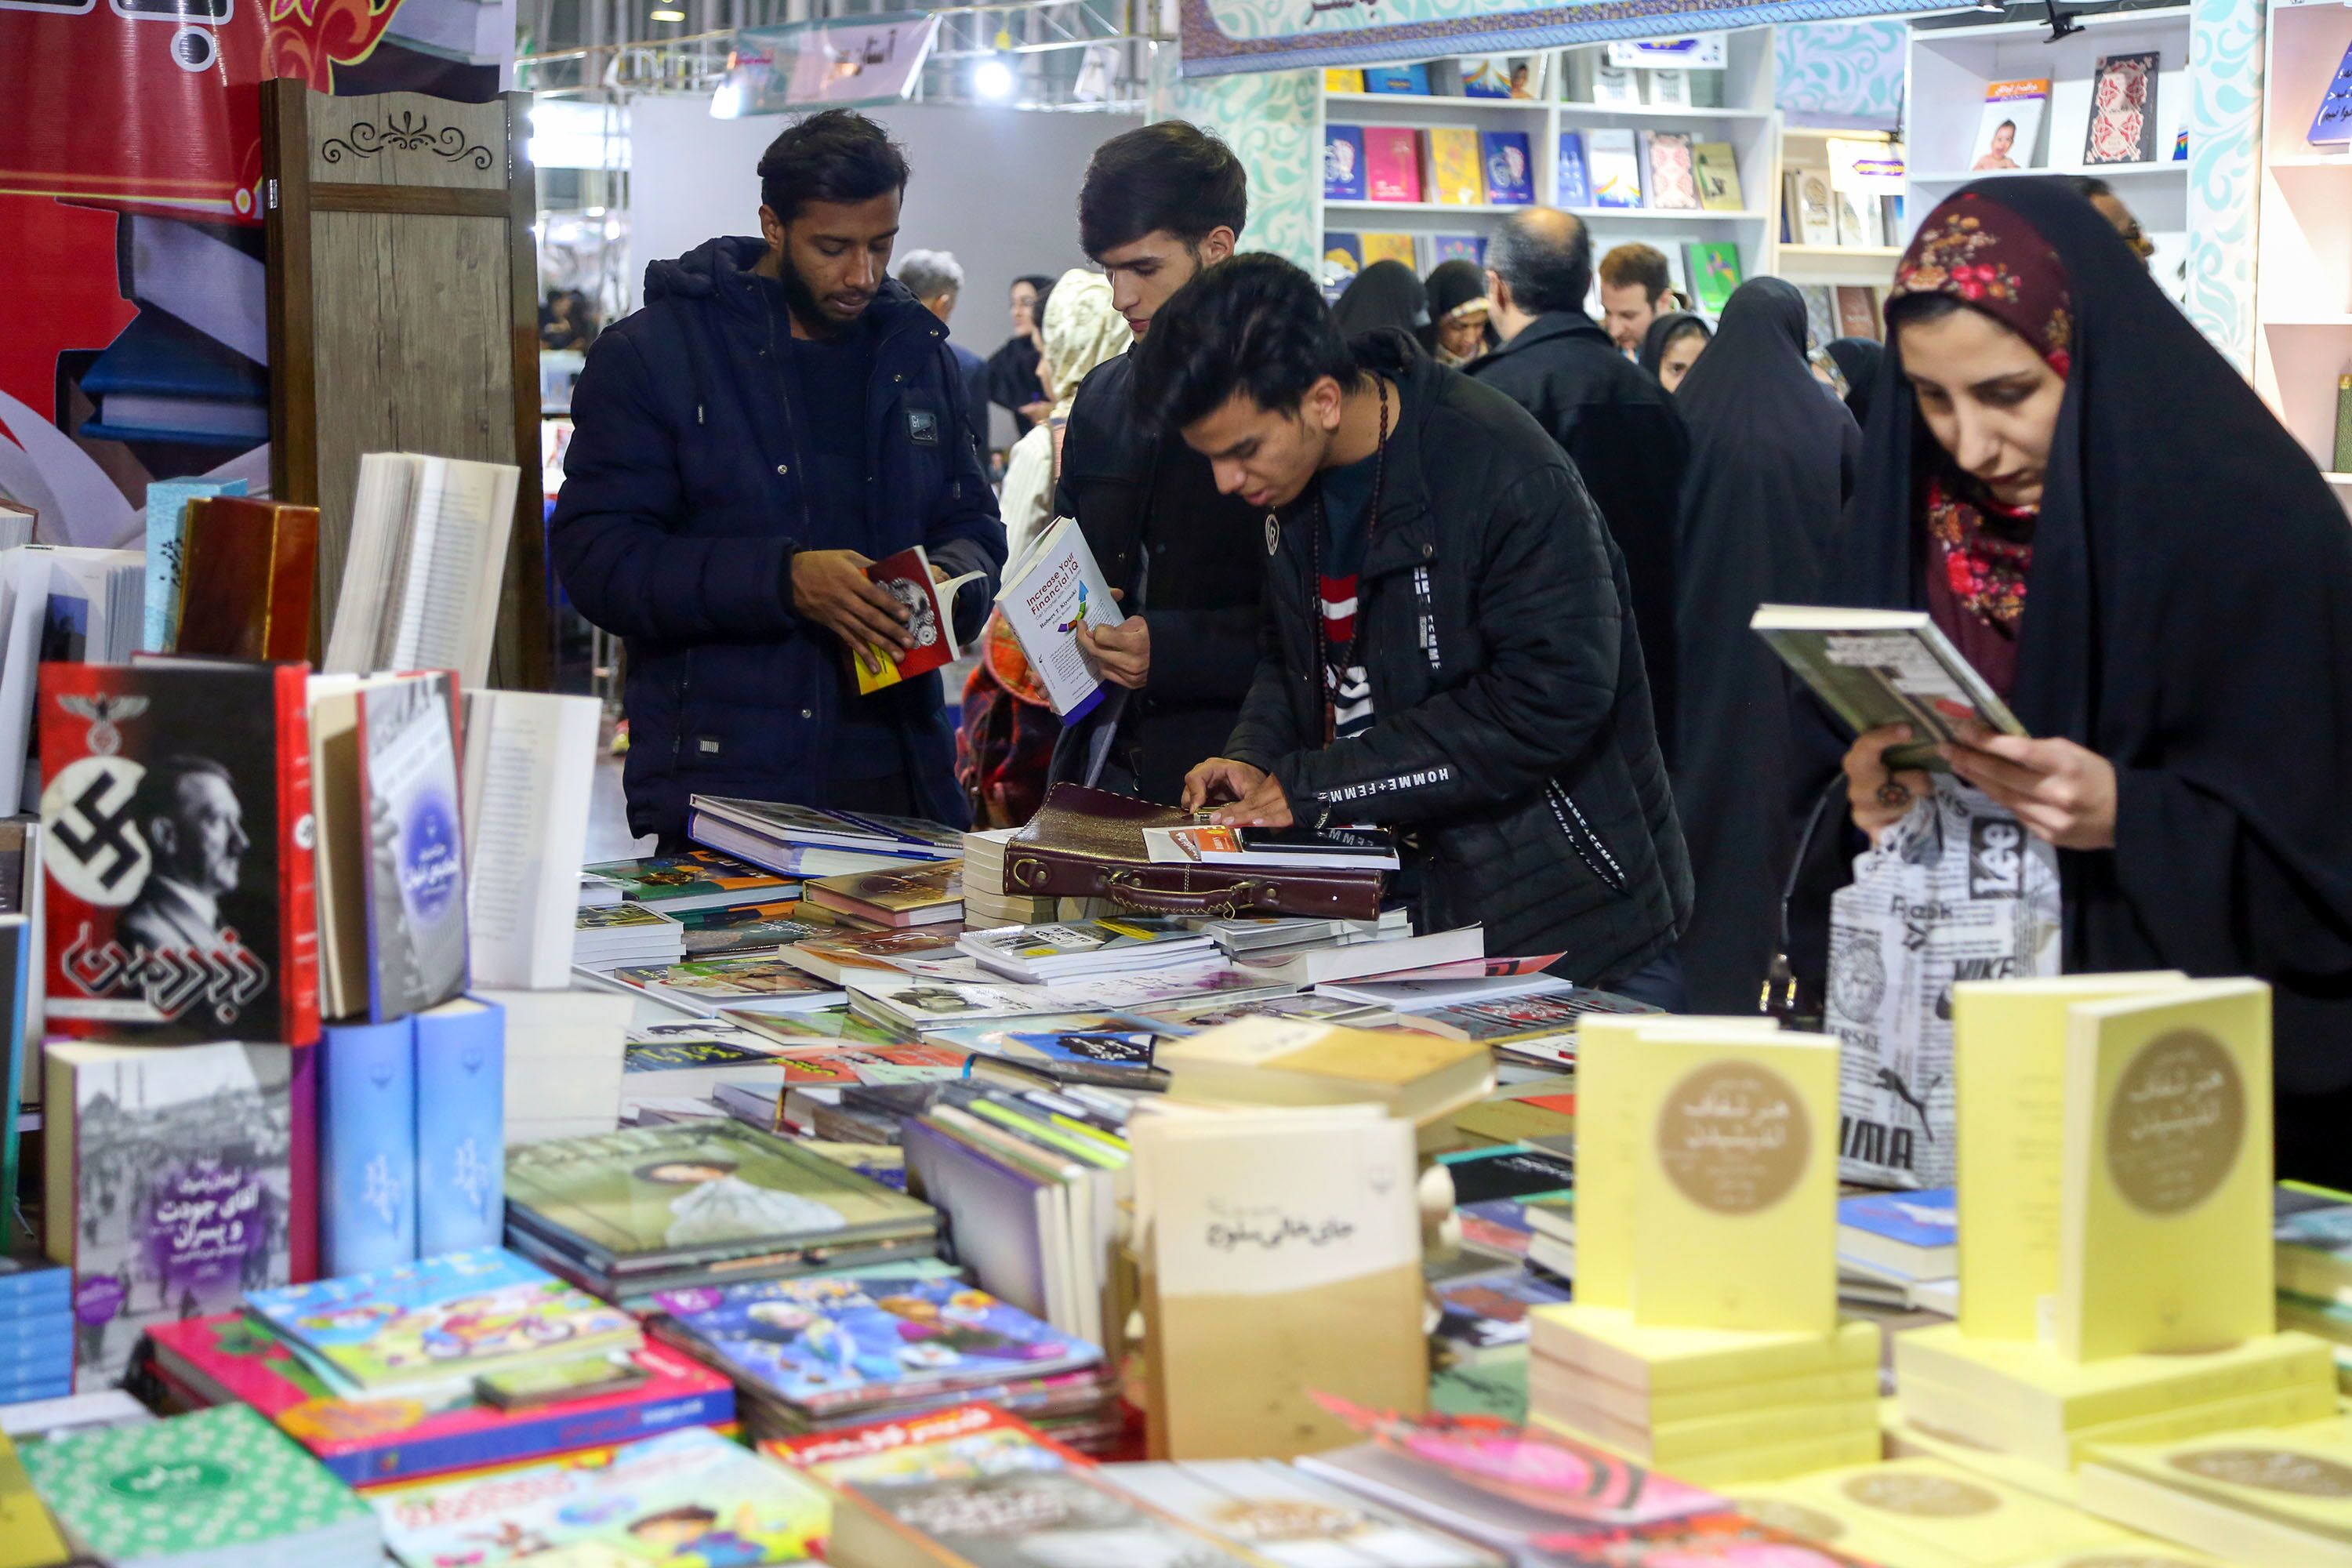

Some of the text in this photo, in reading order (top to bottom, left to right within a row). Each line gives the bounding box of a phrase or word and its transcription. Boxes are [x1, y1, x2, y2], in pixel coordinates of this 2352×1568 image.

[1026, 552, 1074, 607] Increase Your
[1031, 572, 1069, 615] Financial
[1069, 561, 1079, 574] IQ
[1040, 612, 1055, 629] Robert
[1973, 823, 2020, 894] Lee
[220, 1182, 259, 1219] آقای
[228, 1220, 245, 1243] و
[1309, 1220, 1355, 1247] جای
